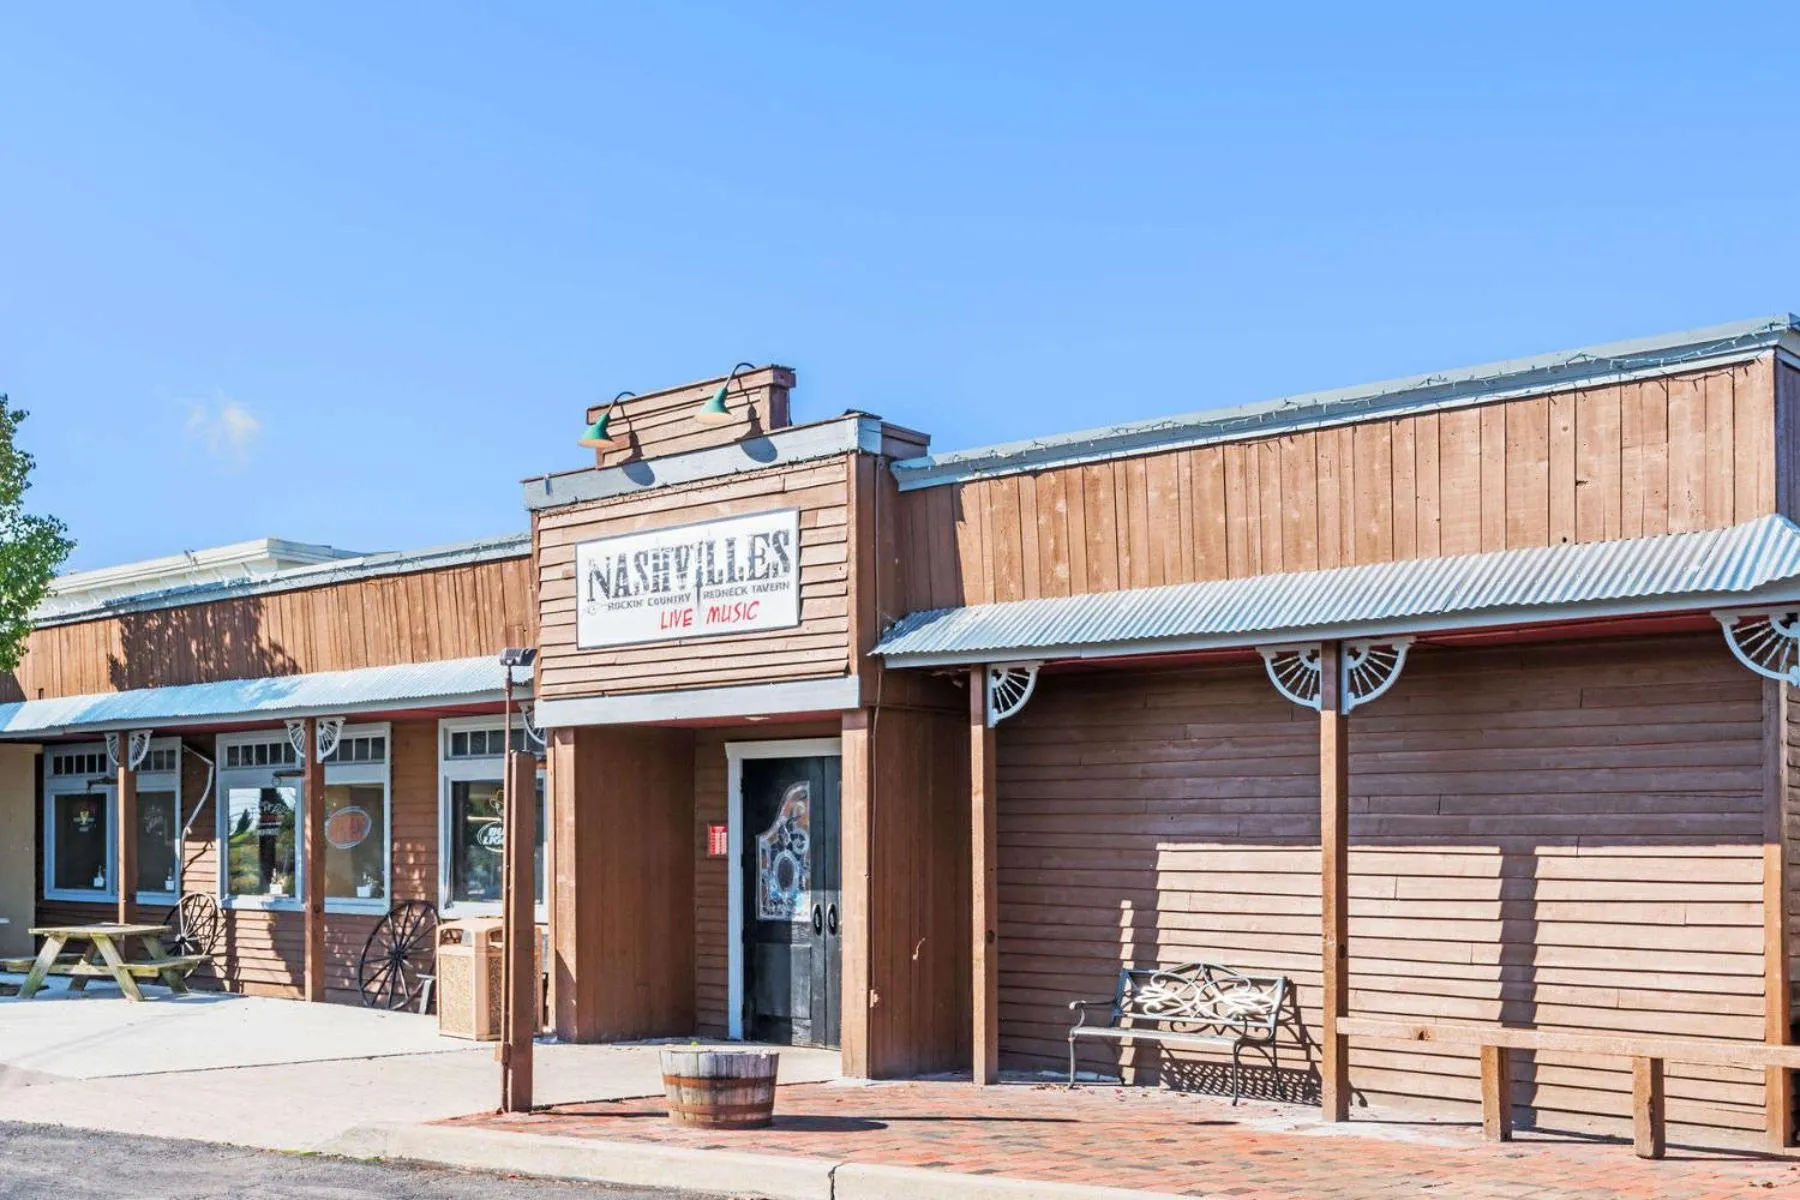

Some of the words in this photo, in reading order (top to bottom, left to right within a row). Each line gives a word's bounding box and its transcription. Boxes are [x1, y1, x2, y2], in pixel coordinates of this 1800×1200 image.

[587, 529, 792, 602] NASHVILLES
[647, 592, 692, 607] COUNTRY
[703, 585, 748, 600] REDNECK
[752, 580, 791, 594] TAVERN
[660, 608, 693, 630] LIVE
[706, 600, 760, 625] MUSIC
